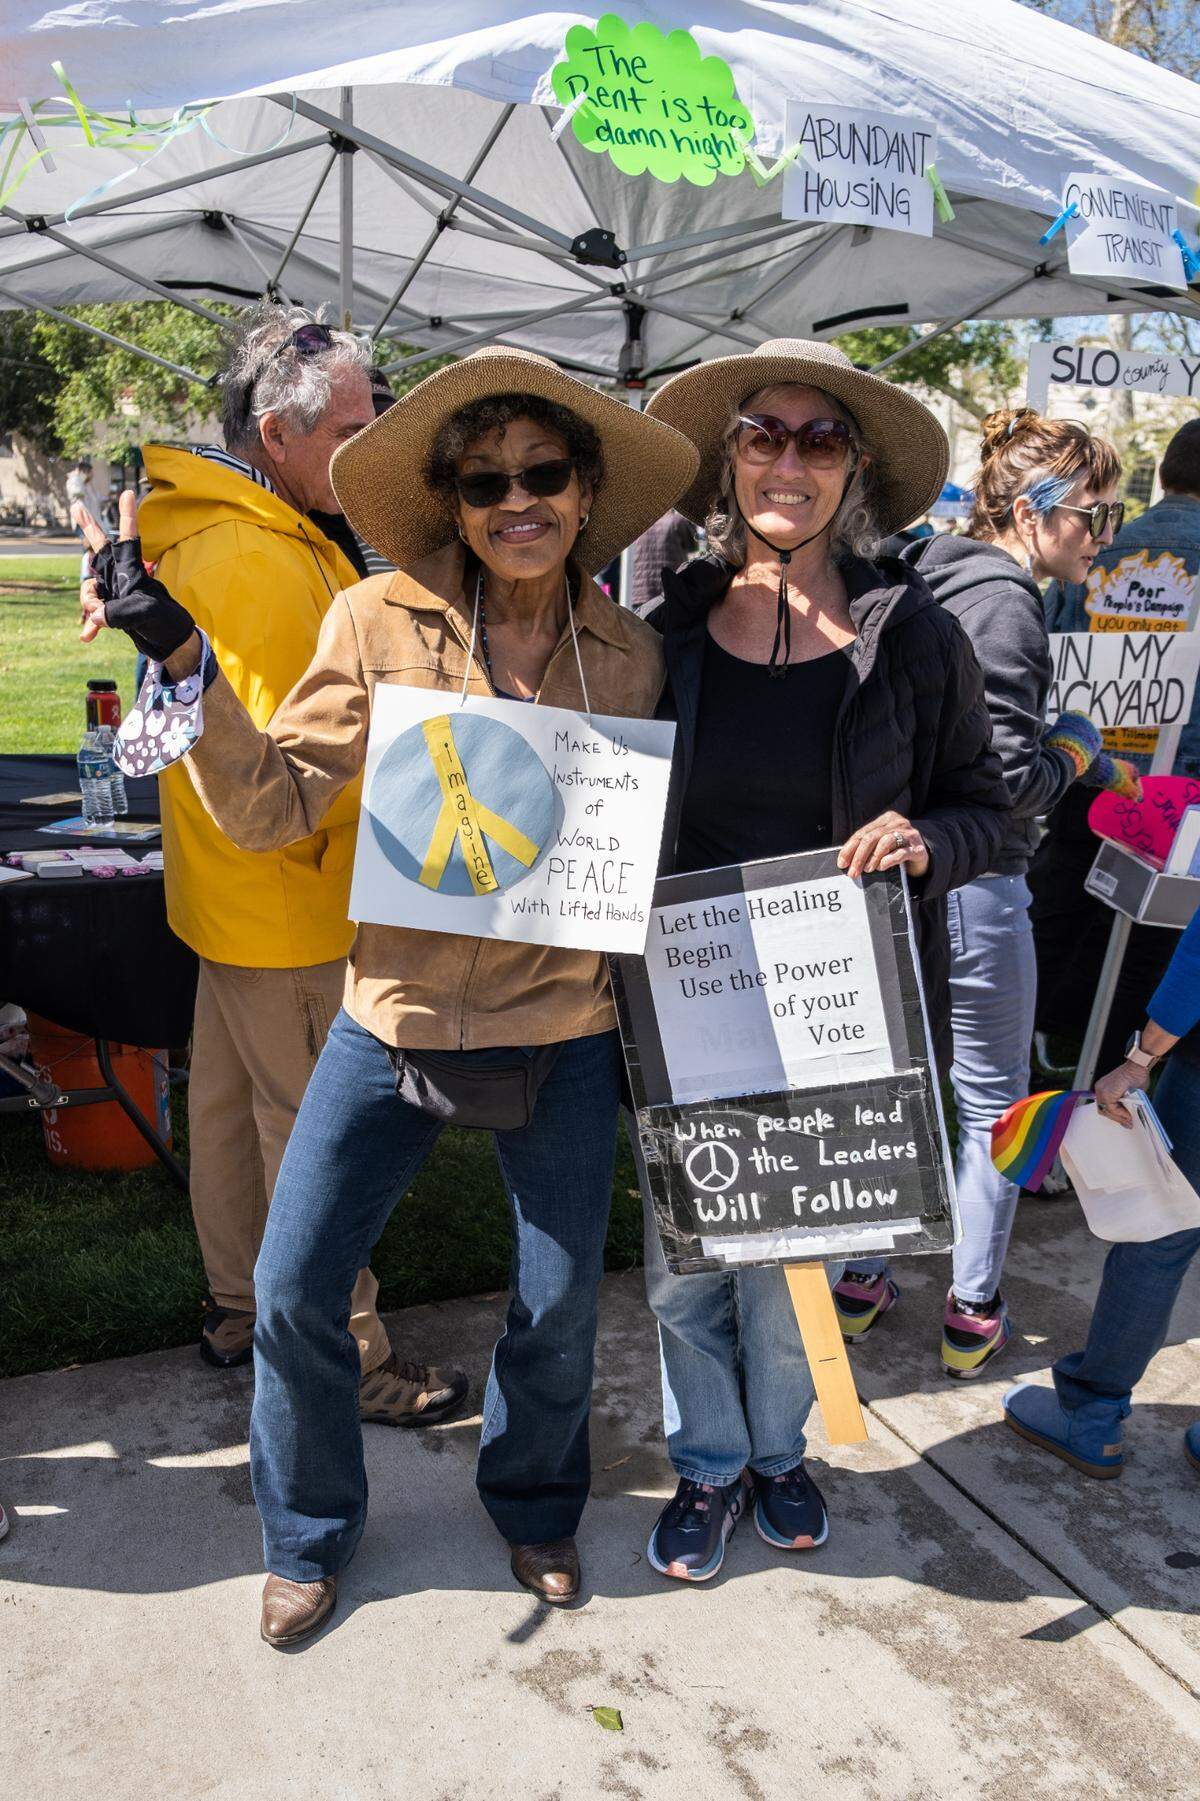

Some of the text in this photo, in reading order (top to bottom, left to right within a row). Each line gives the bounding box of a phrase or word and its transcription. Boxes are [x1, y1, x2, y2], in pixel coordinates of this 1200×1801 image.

[582, 44, 654, 84] The
[564, 74, 748, 129] Rent is too
[595, 118, 742, 170] damn high!
[794, 113, 932, 178] ABUNDANT
[1096, 233, 1164, 268] TRANSIT
[1050, 345, 1120, 387] SLO
[1123, 358, 1171, 391] county
[1103, 594, 1184, 617] People's Campaign
[1127, 581, 1165, 598] Poor
[1056, 634, 1175, 681] IN MY
[1047, 677, 1185, 726] ACKYARD
[443, 742, 492, 887] imagine
[585, 799, 604, 816] of
[556, 828, 620, 851] WORLD
[547, 857, 635, 894] PEACE
[510, 897, 550, 916] With
[559, 900, 601, 921] Lifted
[658, 889, 842, 935] Let the Healing
[665, 940, 733, 969] Begin
[680, 955, 853, 999] Use the Power
[773, 990, 859, 1019] of your
[808, 1022, 865, 1045] Vote
[674, 1100, 903, 1141] When people lead
[748, 1138, 917, 1175] the Leaders
[693, 1178, 898, 1223] Will Follow
